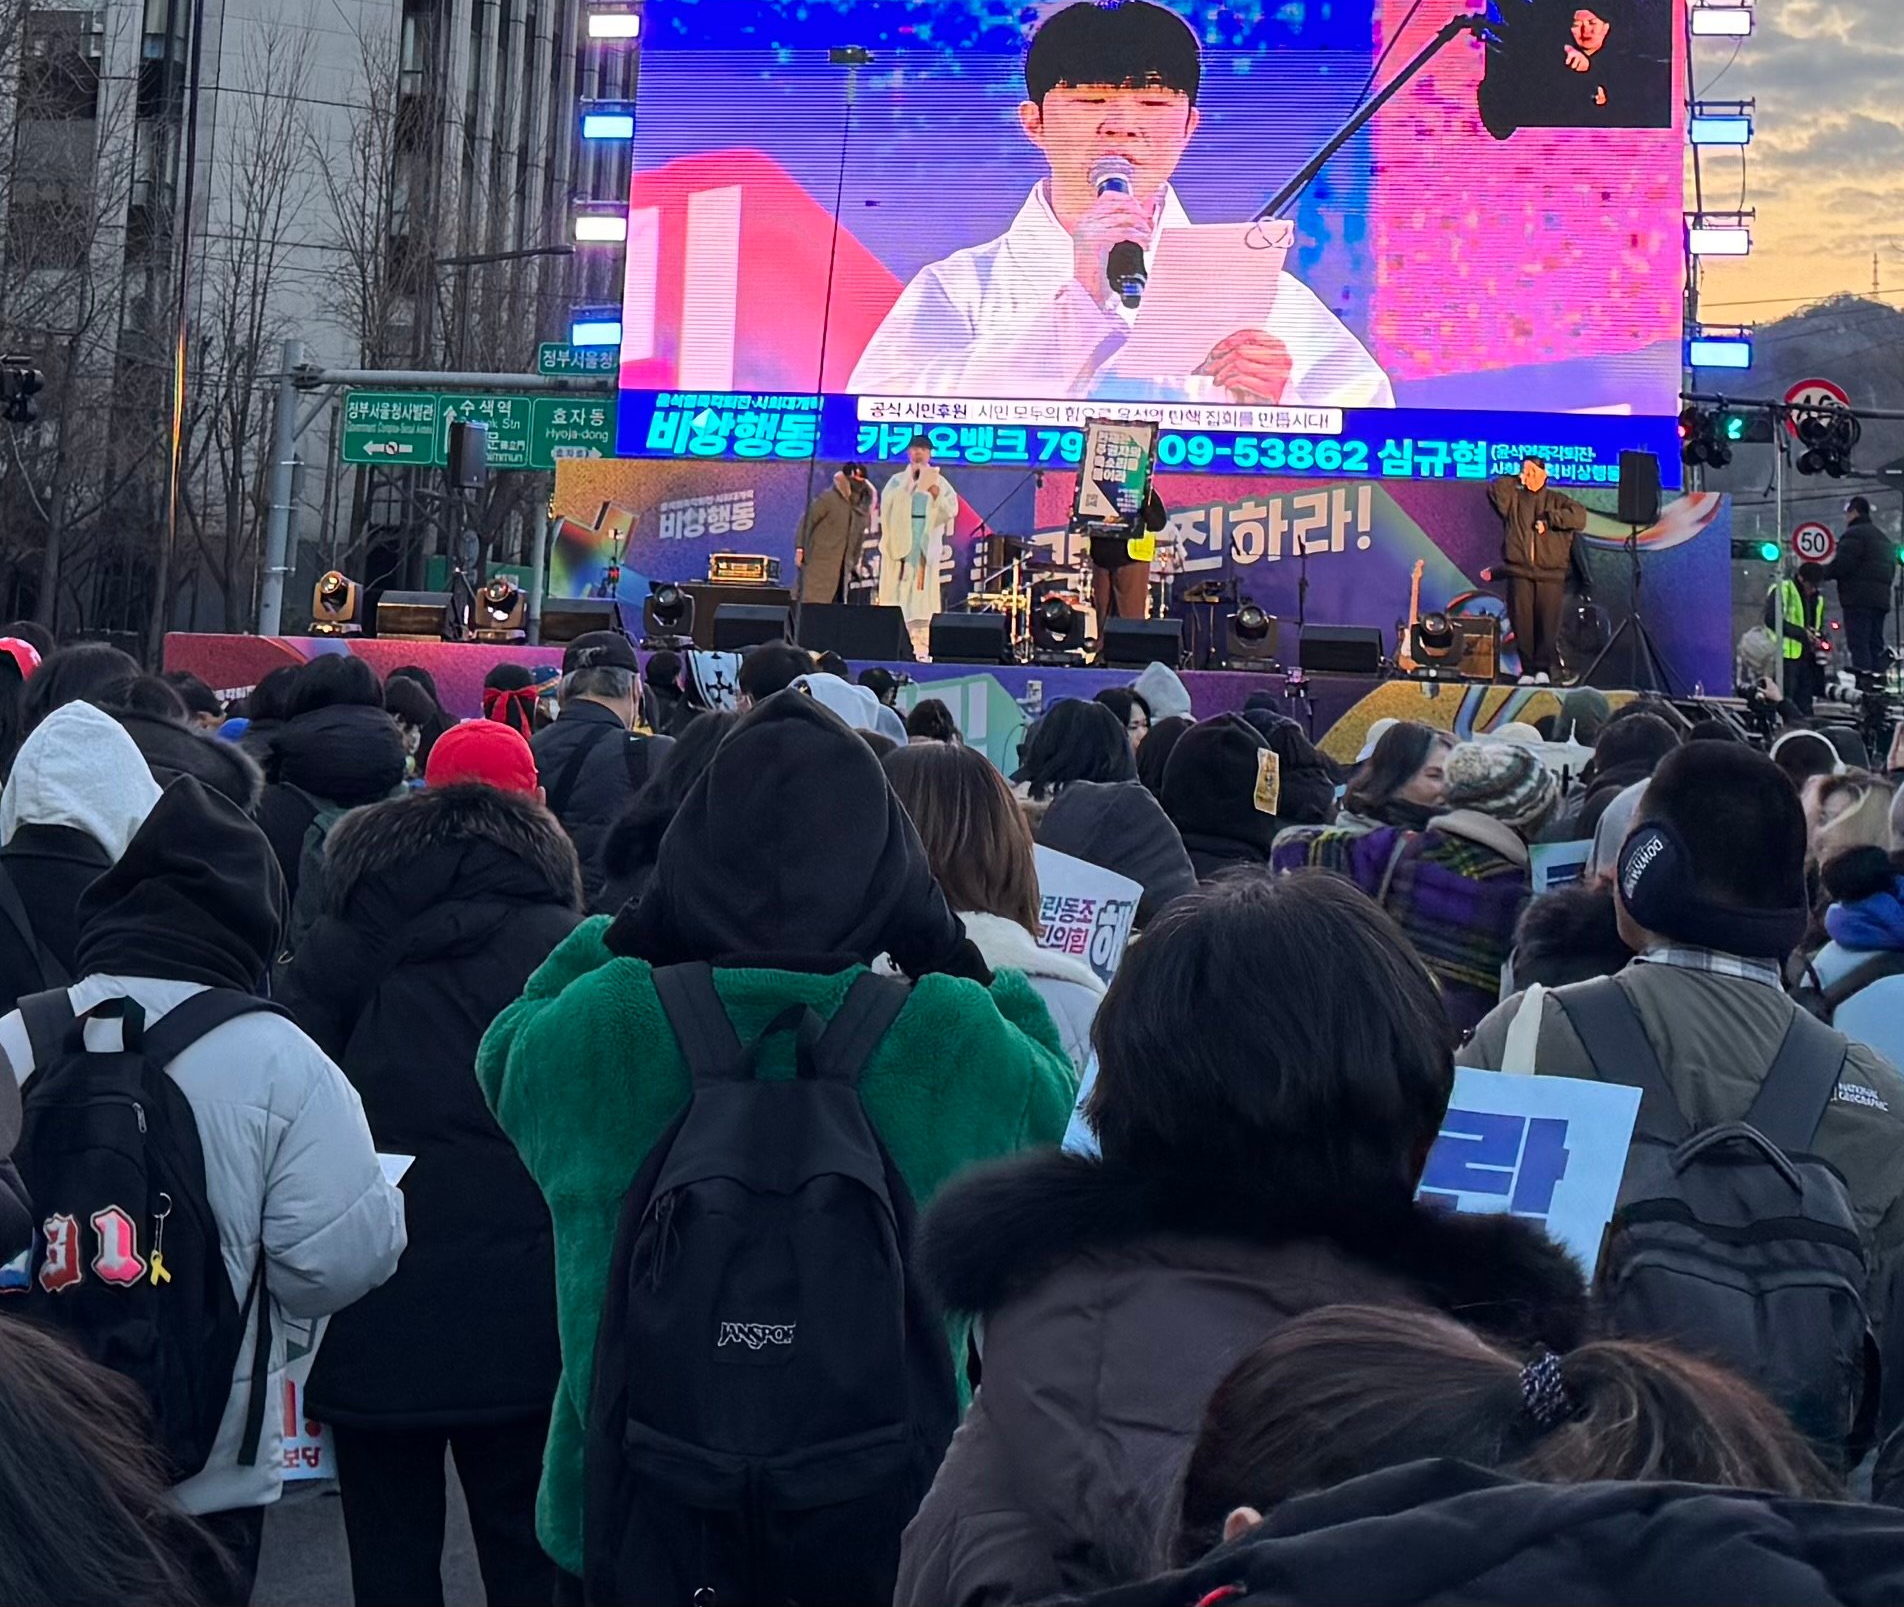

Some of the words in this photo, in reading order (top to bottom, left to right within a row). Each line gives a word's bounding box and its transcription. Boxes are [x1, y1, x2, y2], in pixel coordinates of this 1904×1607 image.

[543, 349, 617, 370] 정부서울청
[460, 400, 512, 418] 수색역
[552, 407, 606, 427] 효자동
[870, 402, 905, 419] 공식
[906, 402, 967, 420] 시민후원
[979, 405, 1009, 421] 시민
[1014, 405, 1060, 423] 모두의
[545, 427, 609, 443] Hyoja-dong
[646, 410, 817, 458] 비상행동
[1377, 438, 1487, 480] 심규협
[1156, 484, 1373, 574] 진하라!
[1801, 532, 1826, 553] 50
[1040, 894, 1097, 924] 란동조
[283, 1446, 322, 1469] 보당
